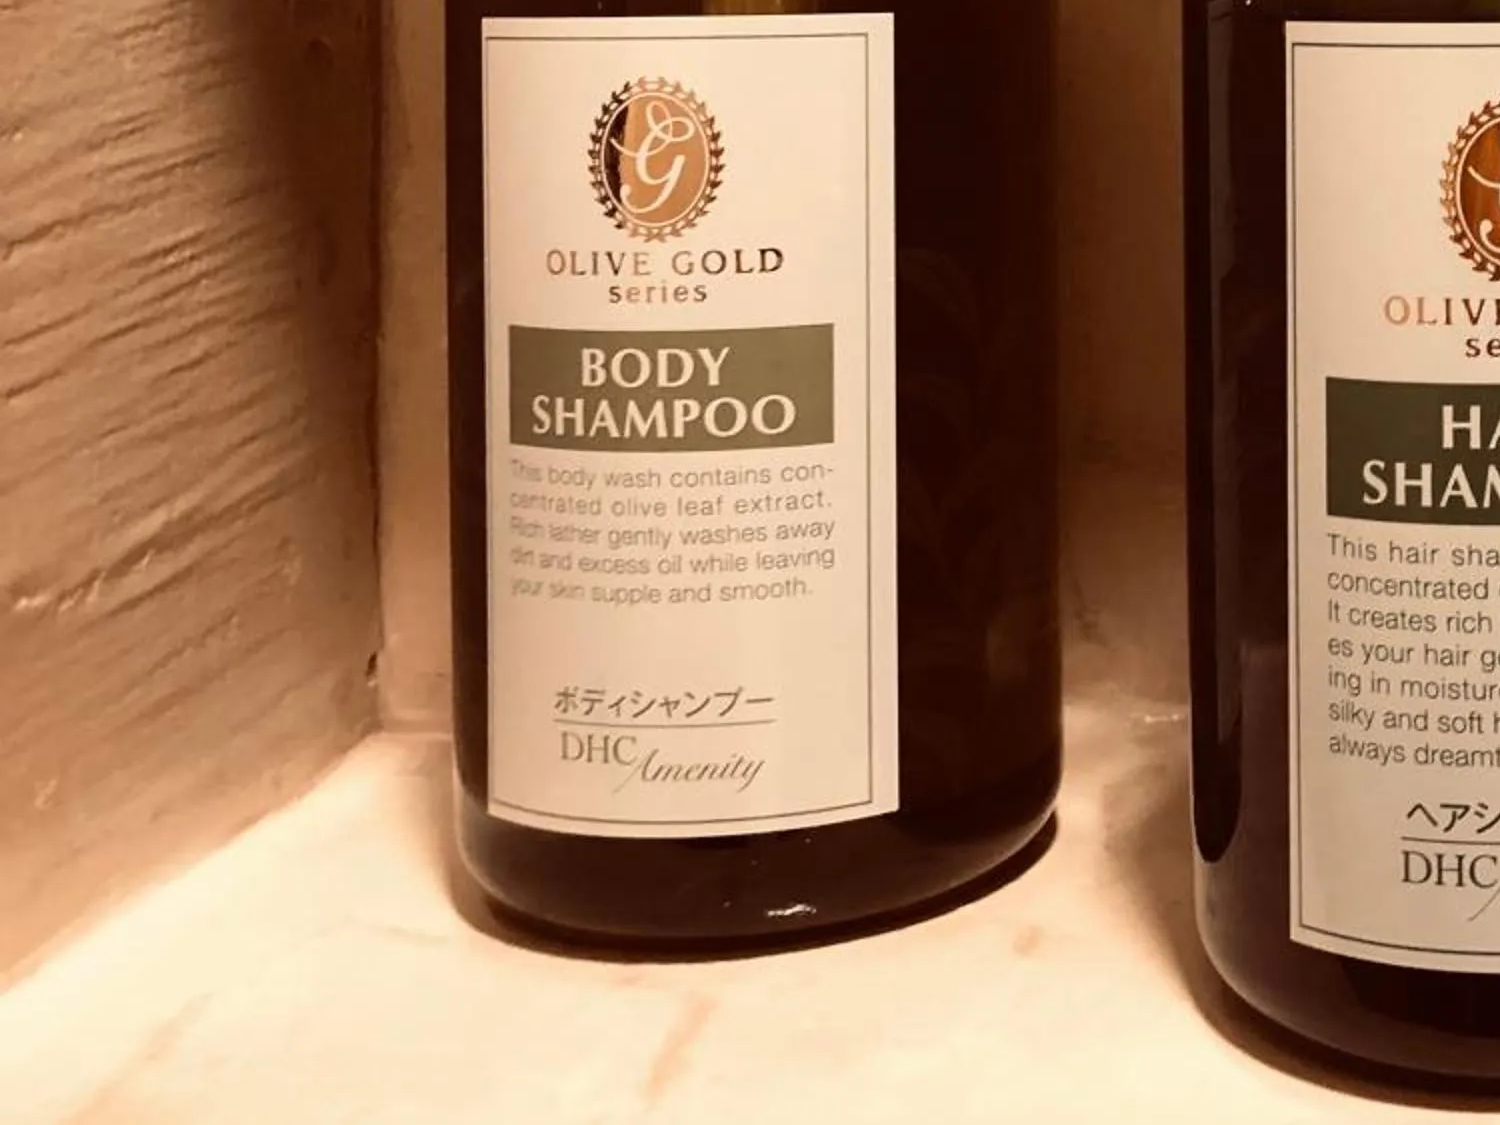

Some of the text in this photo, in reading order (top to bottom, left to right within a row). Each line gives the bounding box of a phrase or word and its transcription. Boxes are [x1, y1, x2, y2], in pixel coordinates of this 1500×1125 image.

[546, 248, 784, 277] OLIVE GOLD
[608, 281, 708, 304] series
[581, 347, 730, 388] BODY
[532, 395, 796, 438] SHAMPOO
[548, 465, 595, 490] body
[604, 467, 661, 488] wash
[670, 465, 770, 488] contains
[781, 462, 834, 483] con-
[510, 491, 832, 517] centrated olive leaf extract.
[548, 521, 599, 545] lather
[608, 524, 671, 550] gently
[680, 521, 766, 544] washes
[775, 520, 836, 544] away
[1327, 532, 1377, 562] This
[1390, 540, 1440, 566] hair
[538, 548, 572, 570] and
[578, 554, 650, 575] excess
[658, 551, 681, 574] oil
[691, 550, 749, 573] while
[756, 547, 835, 572] leaving
[592, 582, 661, 607] supple
[668, 580, 711, 603] and
[719, 577, 812, 603] smooth.
[1327, 570, 1489, 601] concentrated
[1327, 600, 1342, 622] It
[1345, 603, 1437, 632] creates
[1446, 609, 1492, 634] rich
[1327, 639, 1354, 658] es
[1361, 642, 1413, 665] your
[1424, 641, 1468, 667] hair
[1327, 667, 1362, 697] ing
[1370, 670, 1390, 695] in
[554, 687, 775, 718] ボディシャンプー
[1328, 699, 1375, 730] silky
[1383, 704, 1429, 731] and
[1437, 707, 1482, 734] soft
[560, 731, 766, 794] DHC Amenity
[1328, 733, 1405, 766] always
[1401, 850, 1498, 889] DHC
